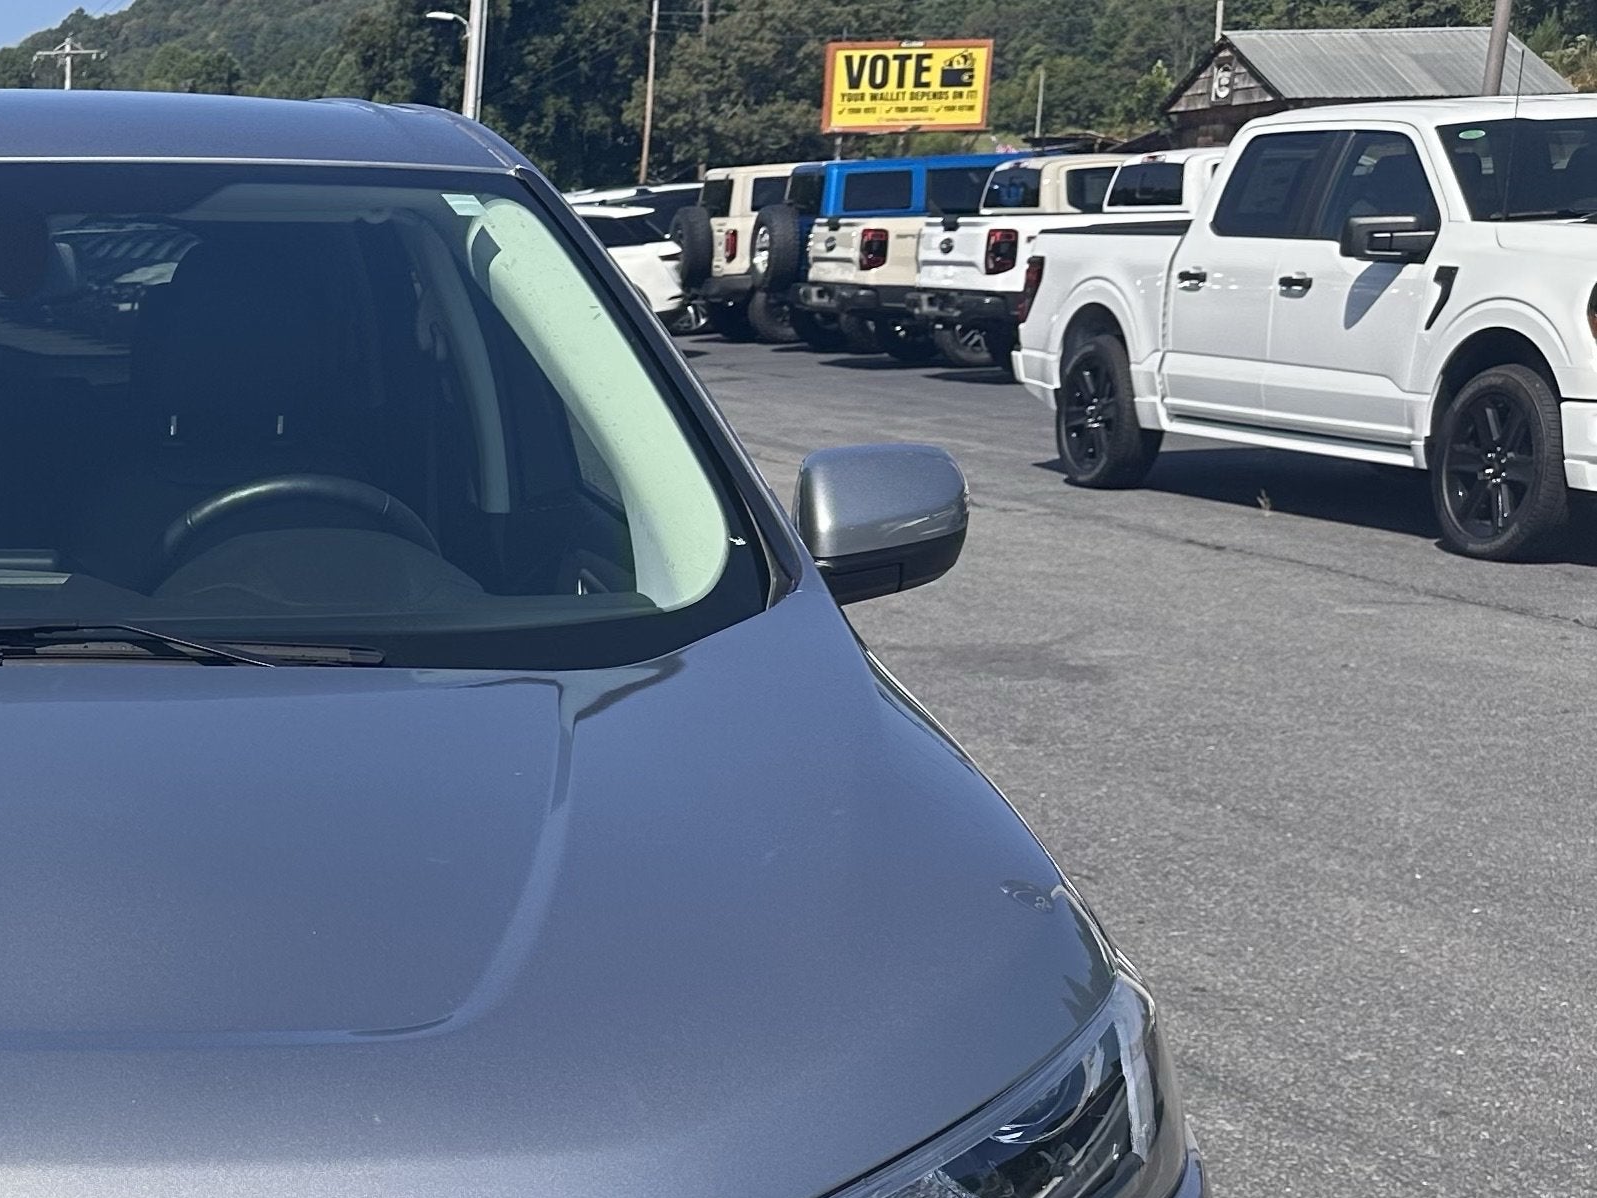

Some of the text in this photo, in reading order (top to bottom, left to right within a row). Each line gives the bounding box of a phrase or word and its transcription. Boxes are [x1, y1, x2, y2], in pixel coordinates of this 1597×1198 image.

[844, 53, 933, 90] VOTE
[840, 92, 865, 102] YOUR
[869, 91, 906, 102] WALLET
[909, 90, 949, 101] DEPENDS
[953, 91, 964, 100] ON
